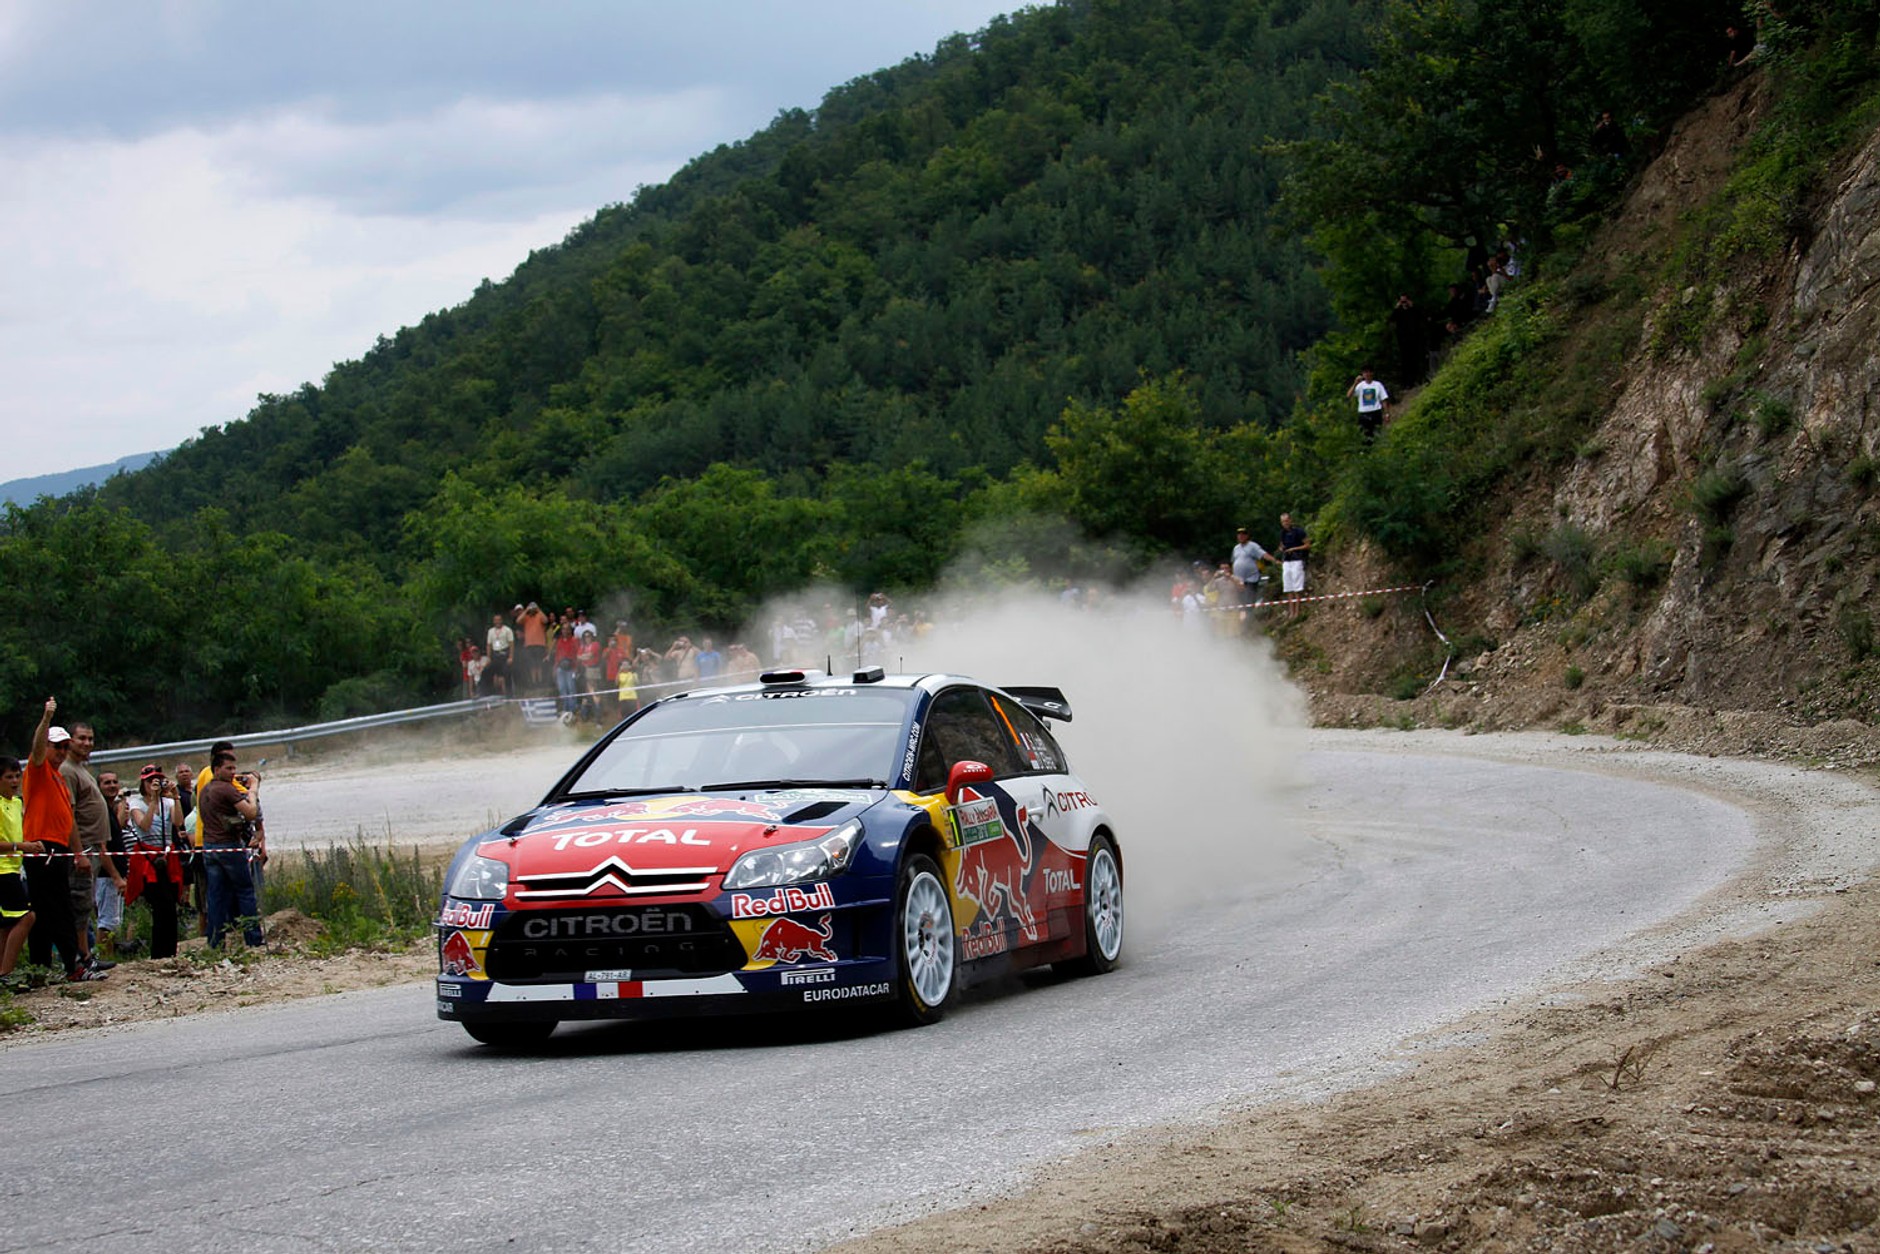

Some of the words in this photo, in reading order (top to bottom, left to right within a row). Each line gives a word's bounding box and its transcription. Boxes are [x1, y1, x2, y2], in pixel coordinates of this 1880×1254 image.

[552, 829, 711, 851] TOTAL
[1043, 868, 1081, 895] TOTAL
[731, 887, 788, 919] Red
[785, 882, 836, 913] Bull
[456, 903, 495, 929] Bull
[524, 942, 695, 956] RACING
[962, 921, 985, 961] Red
[983, 916, 1008, 957] Bull
[781, 968, 835, 985] PIRELLI
[803, 983, 890, 1002] EURODATACAR
